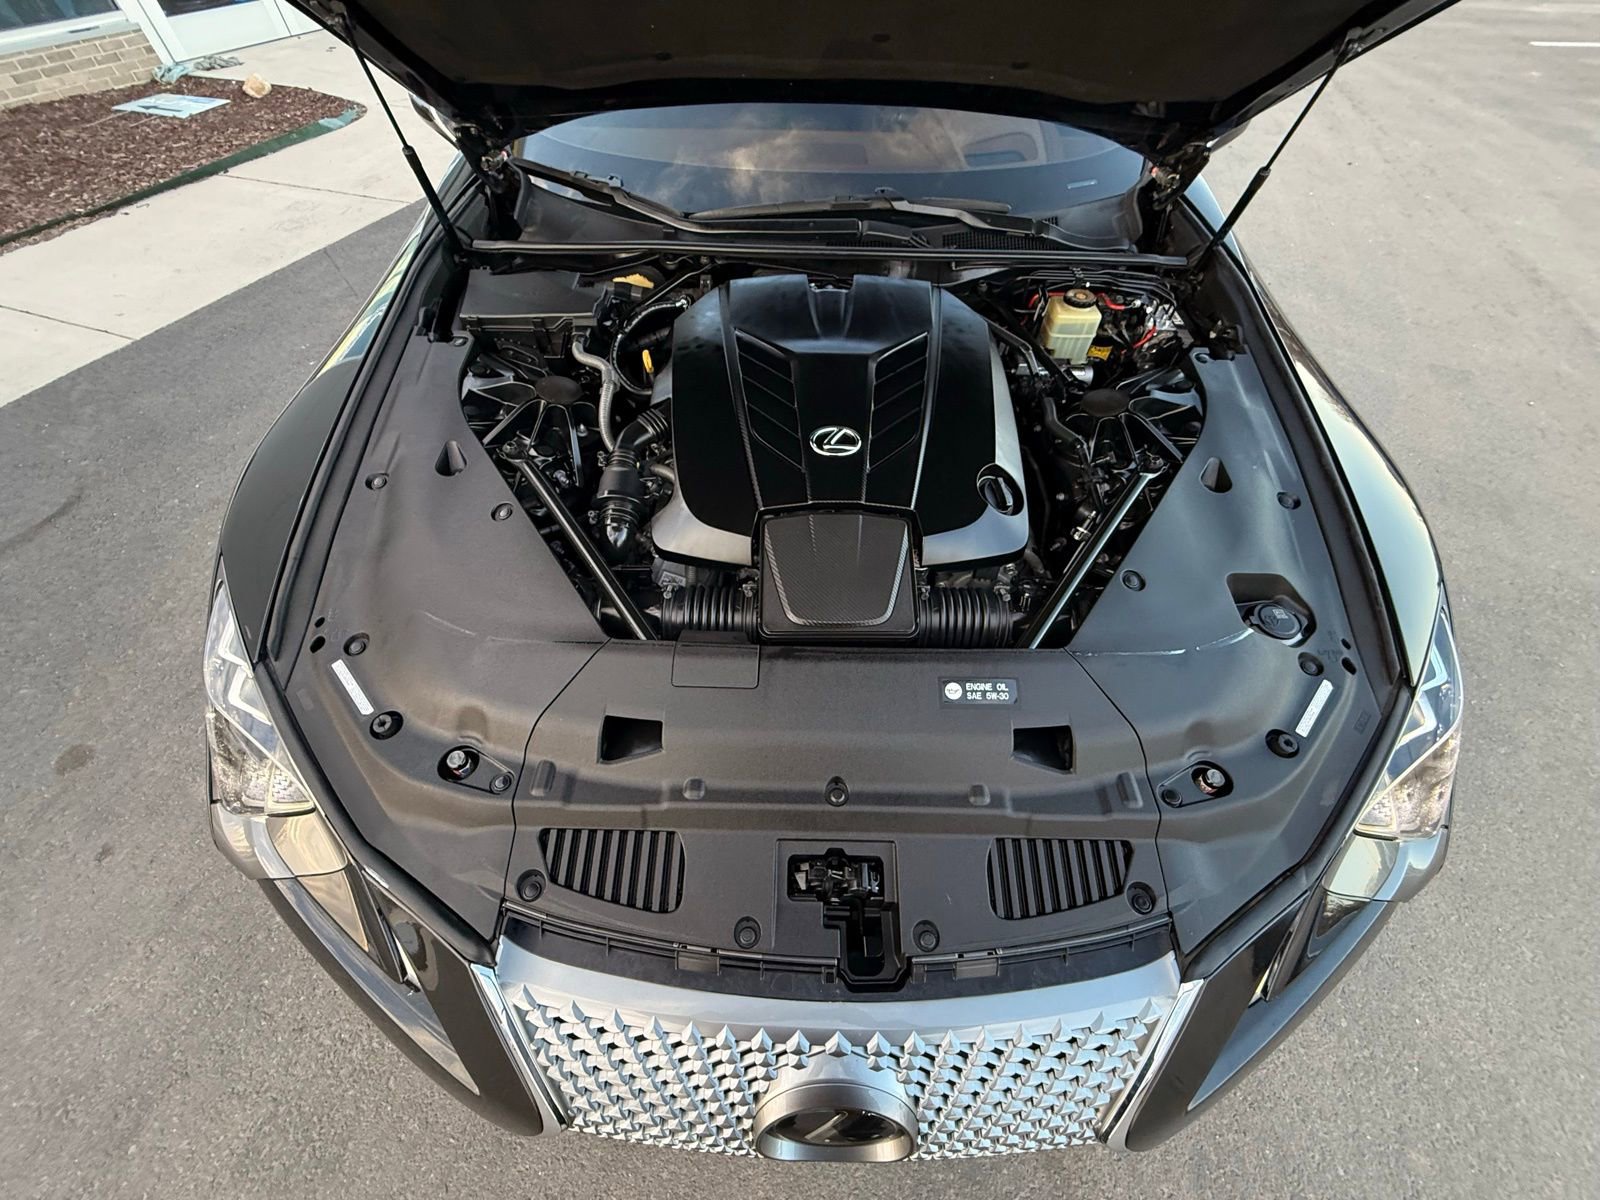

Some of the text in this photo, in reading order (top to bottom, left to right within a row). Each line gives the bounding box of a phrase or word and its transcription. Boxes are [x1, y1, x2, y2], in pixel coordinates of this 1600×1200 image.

[965, 683, 1008, 691] ENGINE OIL
[966, 691, 1009, 700] SAE 5W-30
